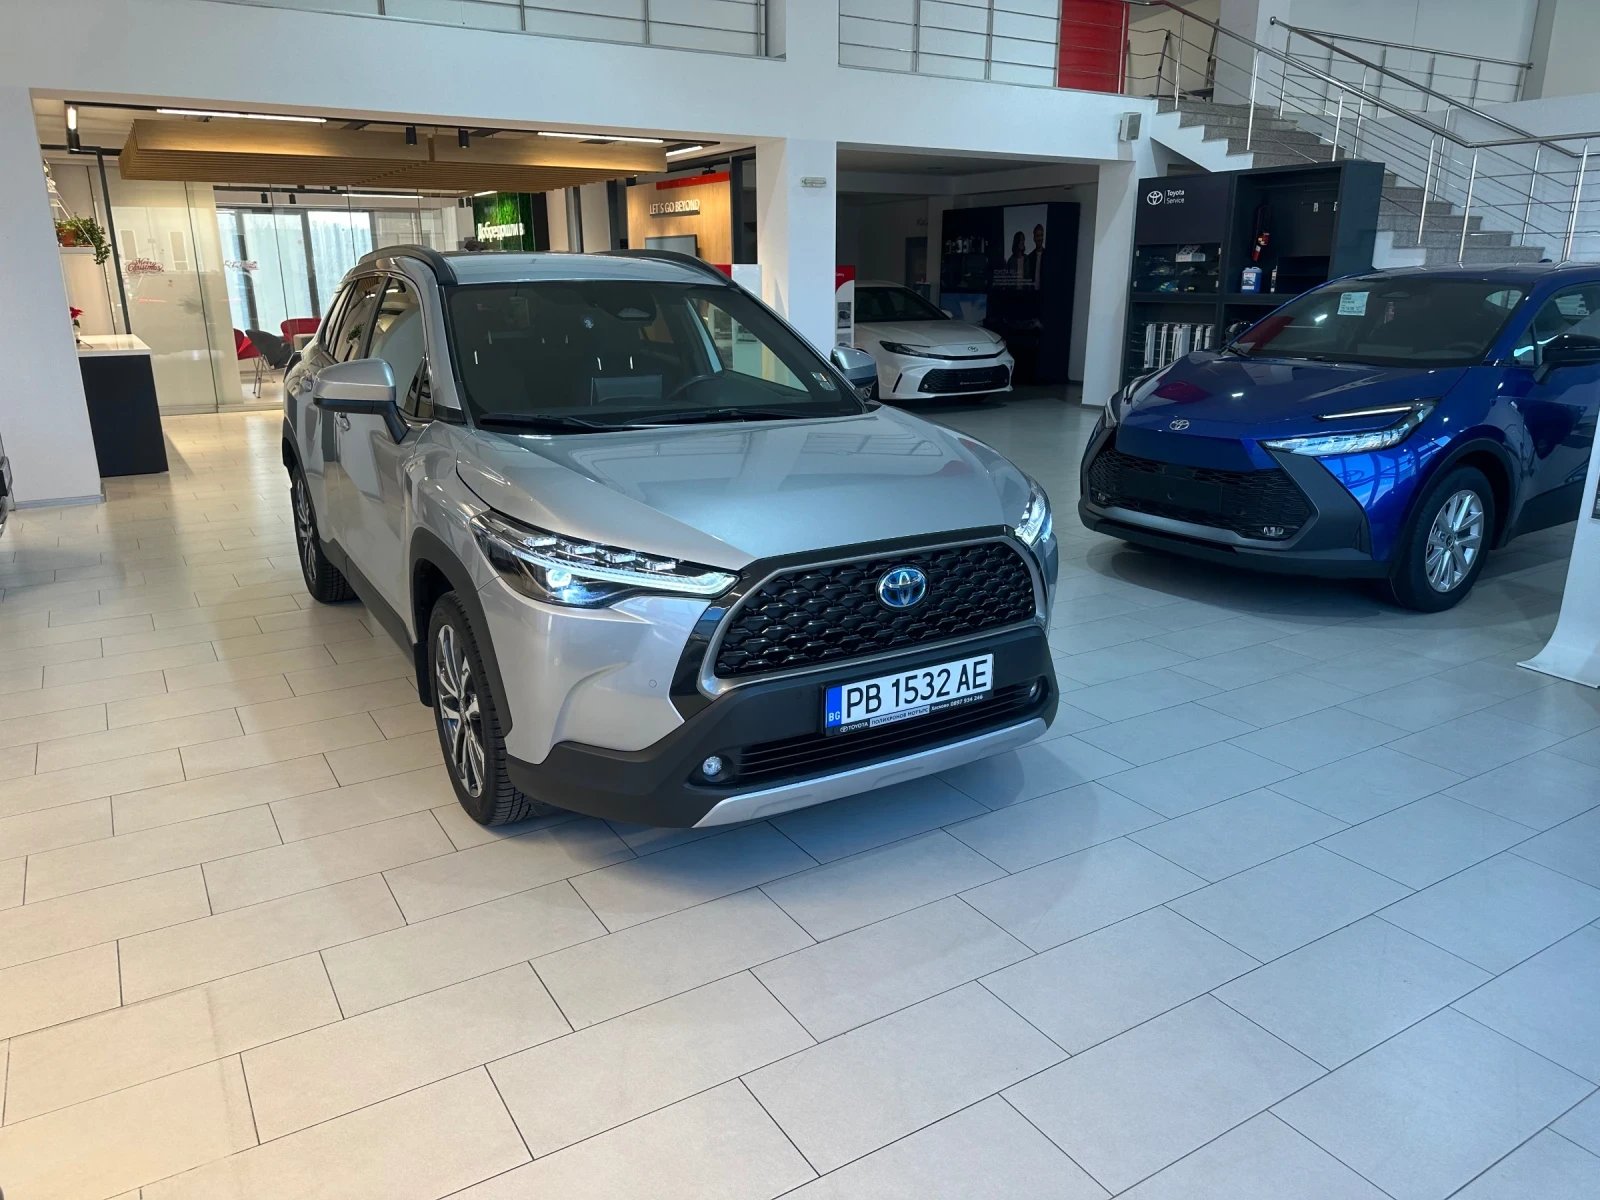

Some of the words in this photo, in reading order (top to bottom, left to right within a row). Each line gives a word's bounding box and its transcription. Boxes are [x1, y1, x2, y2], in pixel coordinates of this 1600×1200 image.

[1167, 189, 1185, 197] Toyota
[664, 201, 675, 213] GO
[675, 199, 700, 212] BEYOND
[846, 683, 882, 719] PB
[891, 668, 950, 708] 1532
[956, 659, 988, 694] AE
[828, 711, 841, 722] BG
[848, 721, 869, 731] TOYOTA
